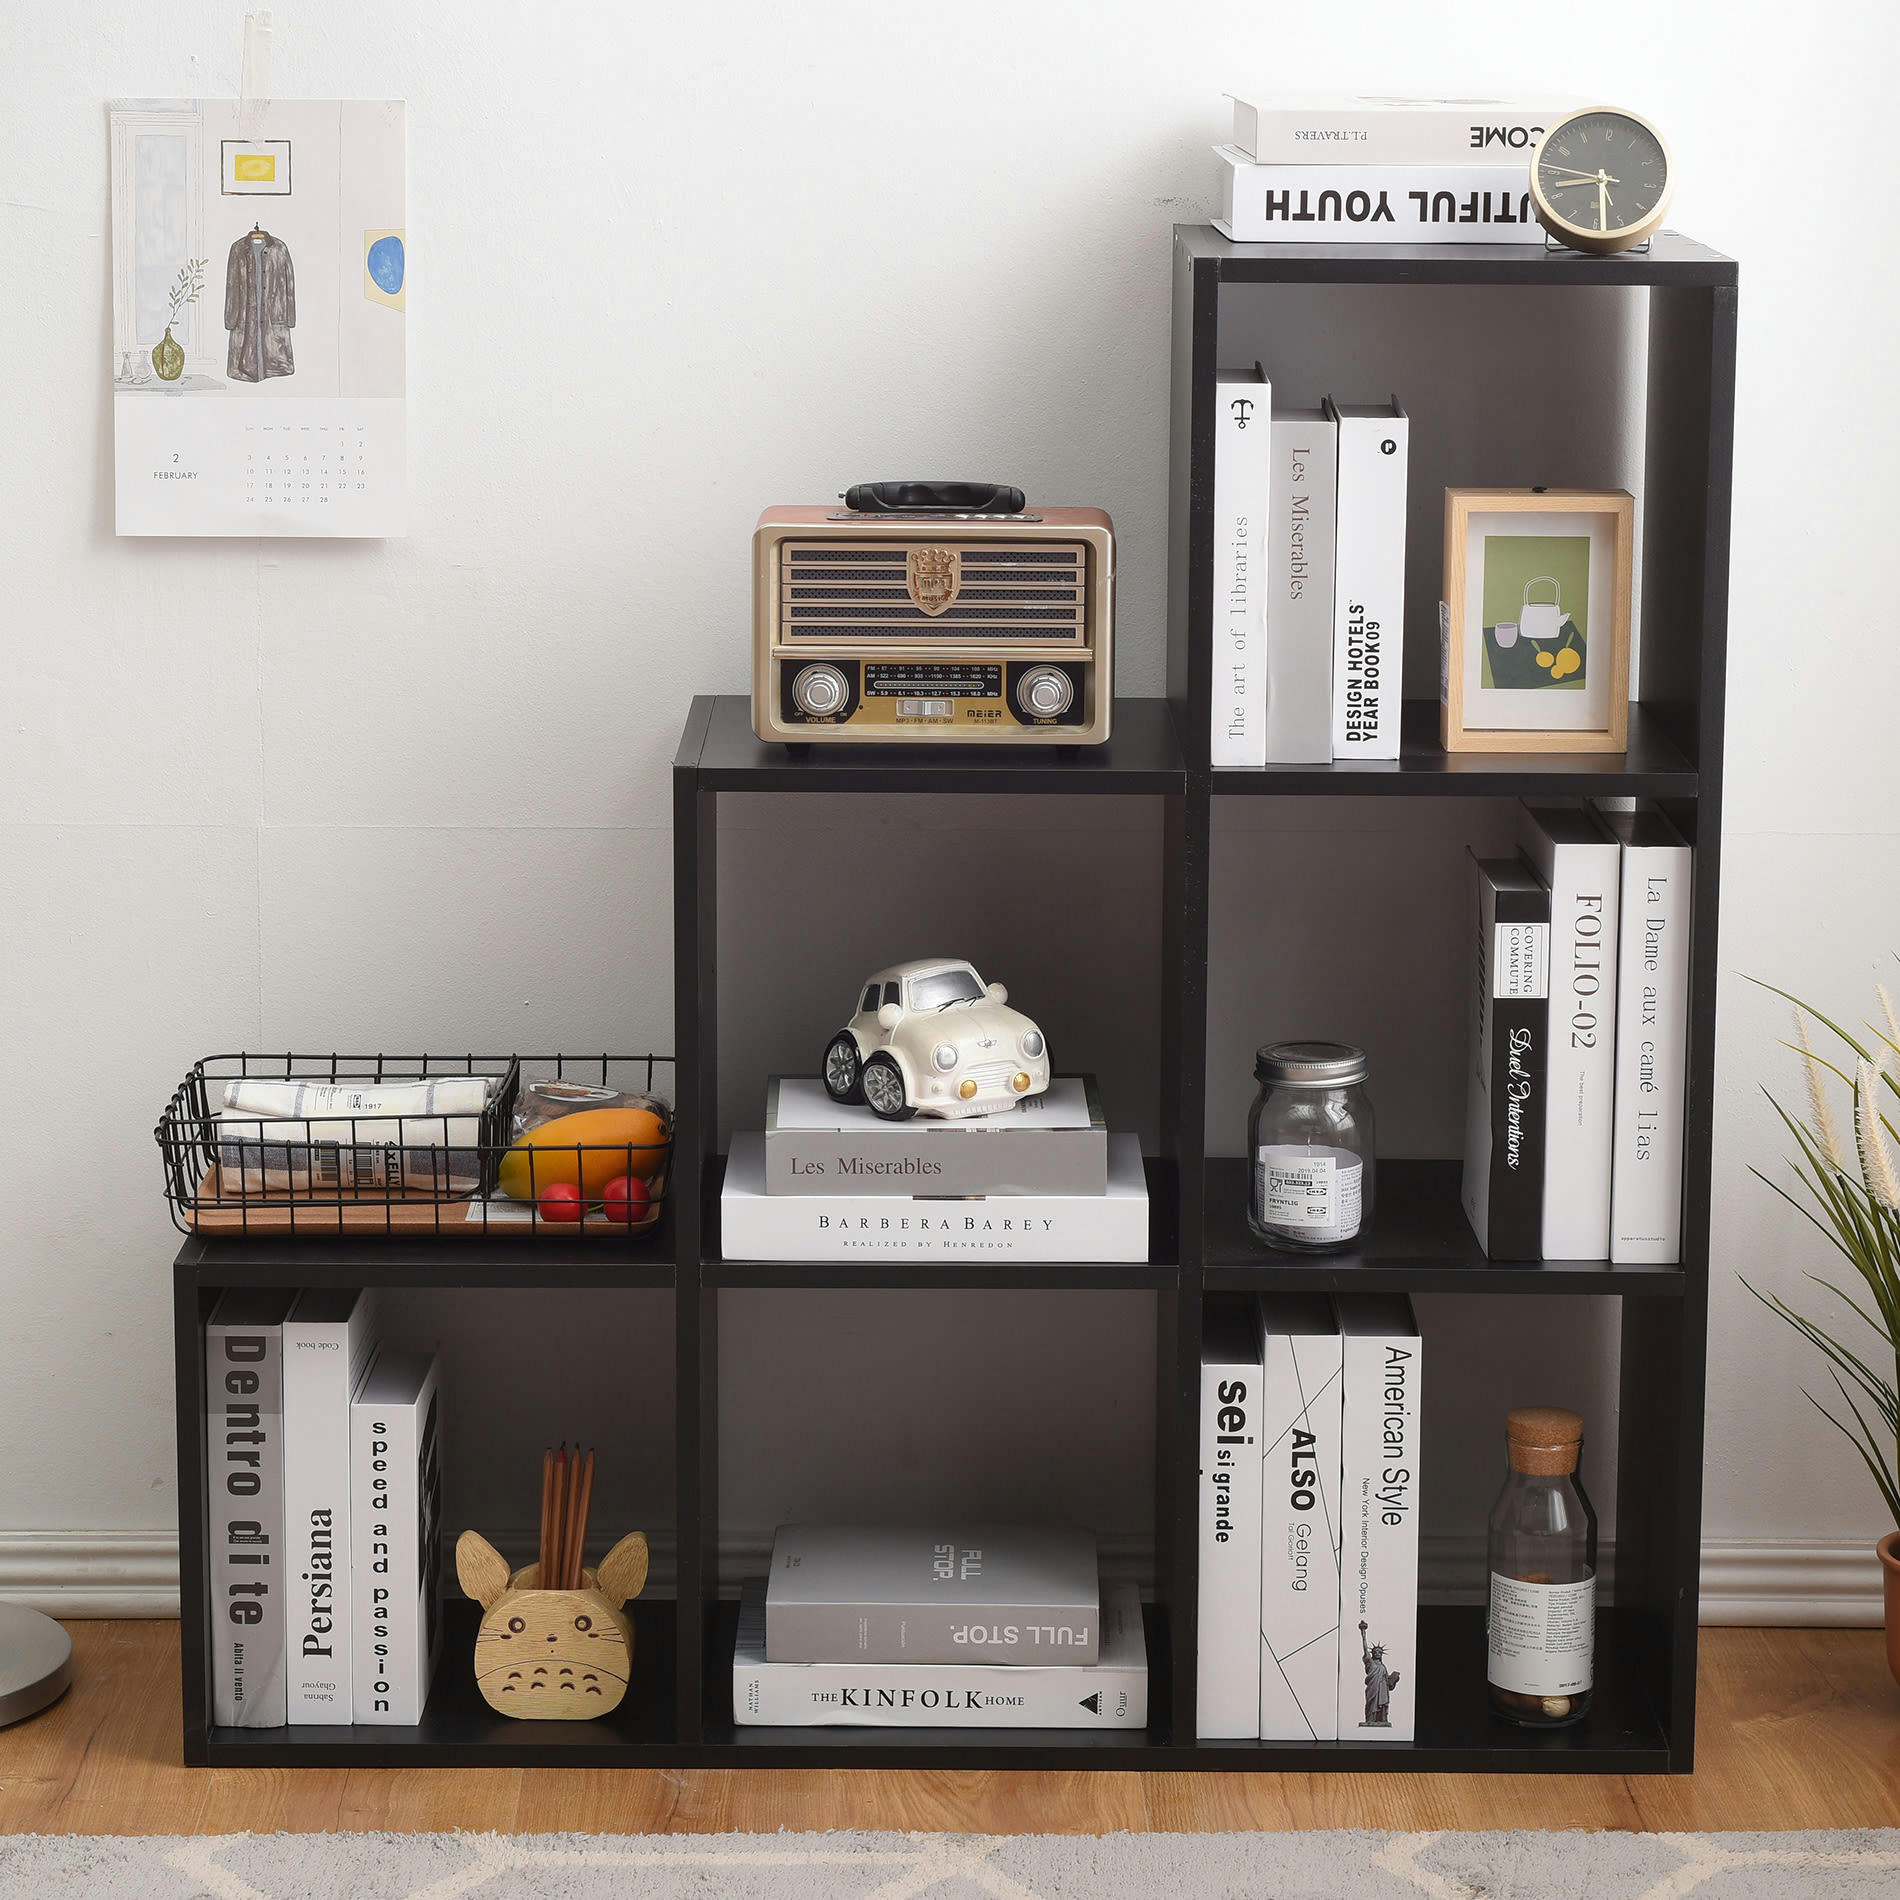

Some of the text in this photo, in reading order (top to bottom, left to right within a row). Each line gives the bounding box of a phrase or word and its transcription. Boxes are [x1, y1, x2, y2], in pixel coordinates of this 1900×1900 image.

[1294, 130, 1368, 141] P.L.TRAVERS
[1470, 126, 1547, 150] COME
[1579, 131, 1588, 144] 11
[1605, 128, 1613, 142] 12
[1628, 134, 1642, 150] 1
[1558, 144, 1571, 157] 10
[1641, 159, 1655, 167] 2
[1265, 189, 1396, 223] YOUTH
[1551, 192, 1564, 200] 8
[1636, 202, 1647, 211] 4
[1567, 209, 1578, 219] 7
[1592, 218, 1599, 230] 6
[1616, 215, 1625, 226] 5
[172, 453, 179, 463] 2
[153, 471, 198, 480] FEBRUARY
[1290, 448, 1311, 600] Les Miserables
[1228, 517, 1248, 740] The art of libraries
[1345, 604, 1365, 742] DESIGN HOTELS
[1362, 621, 1381, 742] YEAR BOOK09
[967, 709, 1002, 718] MEIER
[1509, 927, 1520, 995] COMMUTE
[1523, 925, 1534, 993] COVERING
[1571, 893, 1603, 1049] FOLIO-02
[1636, 878, 1668, 1161] La Dame aux camé lias
[1508, 1027, 1533, 1083] Duel
[791, 1157, 942, 1175] Les Miserables
[819, 1215, 1051, 1231] BARBERA BAREY
[843, 1240, 907, 1248] REALIZED
[943, 1240, 1013, 1249] HENREDON
[295, 1341, 340, 1351] Code book
[224, 1335, 267, 1496] Dentro
[1378, 1346, 1413, 1526] American Style
[1211, 1380, 1254, 1543] sei si grande
[1290, 1428, 1317, 1512] ALSO
[227, 1520, 270, 1565] di
[1358, 1477, 1371, 1614] New York Interior Design Opuses
[372, 1422, 390, 1712] speed and passion
[932, 1544, 955, 1582] STOP.
[960, 1549, 983, 1581] FULL
[1290, 1523, 1312, 1591] Gelang
[301, 1507, 333, 1659] Persiana
[228, 1581, 269, 1625] te
[949, 1625, 1088, 1646] FULL STOP.
[234, 1676, 244, 1701] vento
[301, 1680, 336, 1691] Ghayour
[303, 1693, 334, 1702] Sabrina
[813, 1688, 1025, 1709] THE KINFOLK HOME
